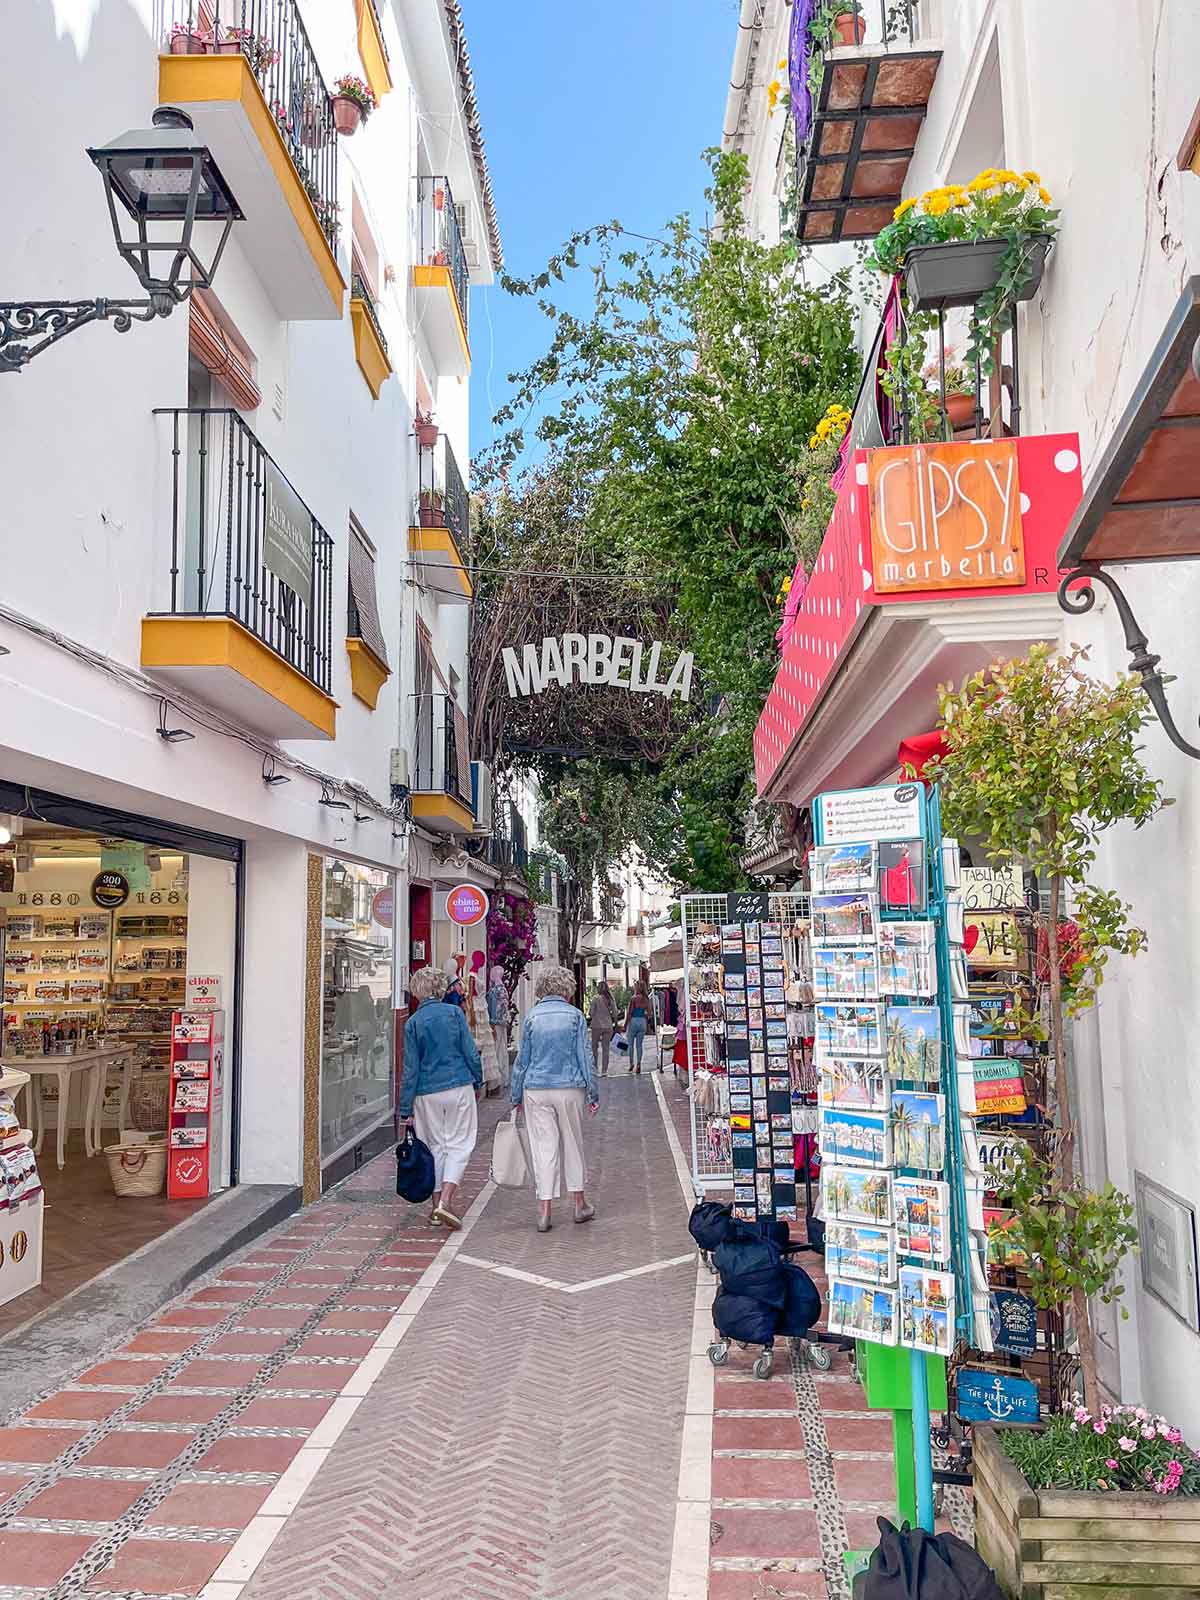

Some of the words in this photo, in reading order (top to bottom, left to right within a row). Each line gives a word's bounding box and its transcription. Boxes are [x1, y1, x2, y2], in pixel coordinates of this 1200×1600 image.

[884, 553, 1014, 581] marbella
[502, 633, 694, 702] MARBELLA
[102, 875, 121, 885] 300
[17, 892, 80, 906] 1880
[980, 1001, 1002, 1009] OCEAN
[981, 1098, 1018, 1110] ALWAYS
[967, 1388, 982, 1397] THE
[984, 1393, 1009, 1404] PIRATE
[1011, 1397, 1027, 1408] LIFE
